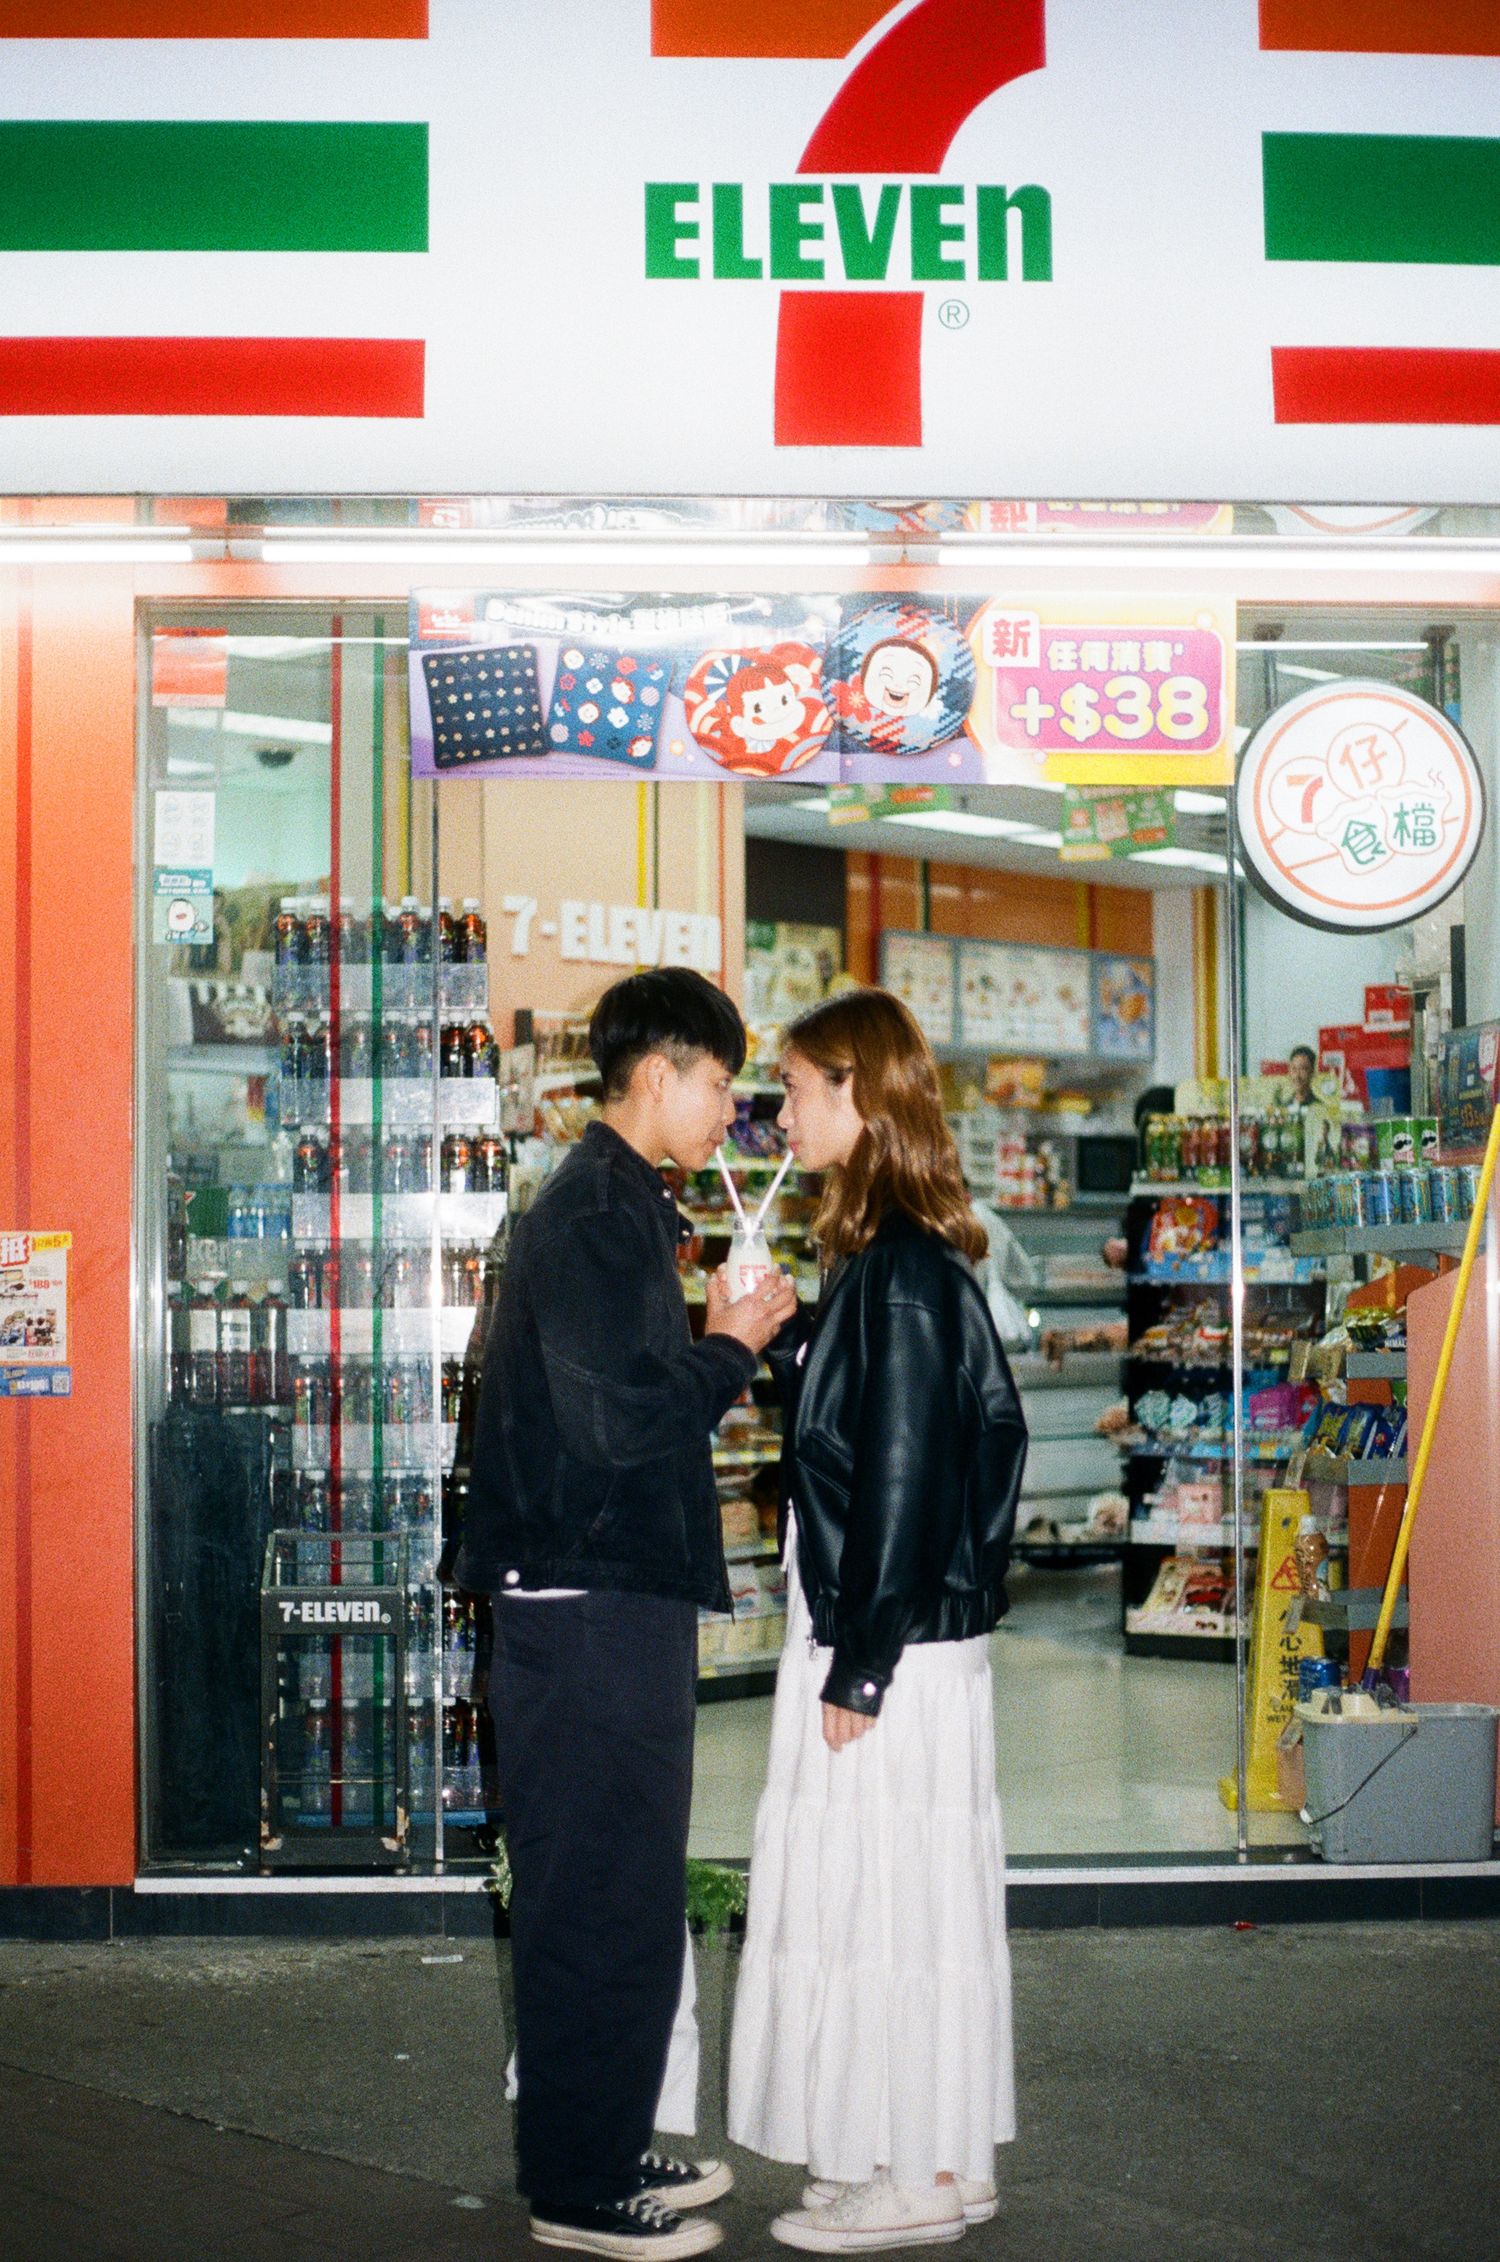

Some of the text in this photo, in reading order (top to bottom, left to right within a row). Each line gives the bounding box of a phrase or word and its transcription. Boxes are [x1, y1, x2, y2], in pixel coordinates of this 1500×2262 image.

[652, 0, 1045, 446] 7
[992, 619, 1031, 658] 新
[1009, 675, 1210, 742] +$38
